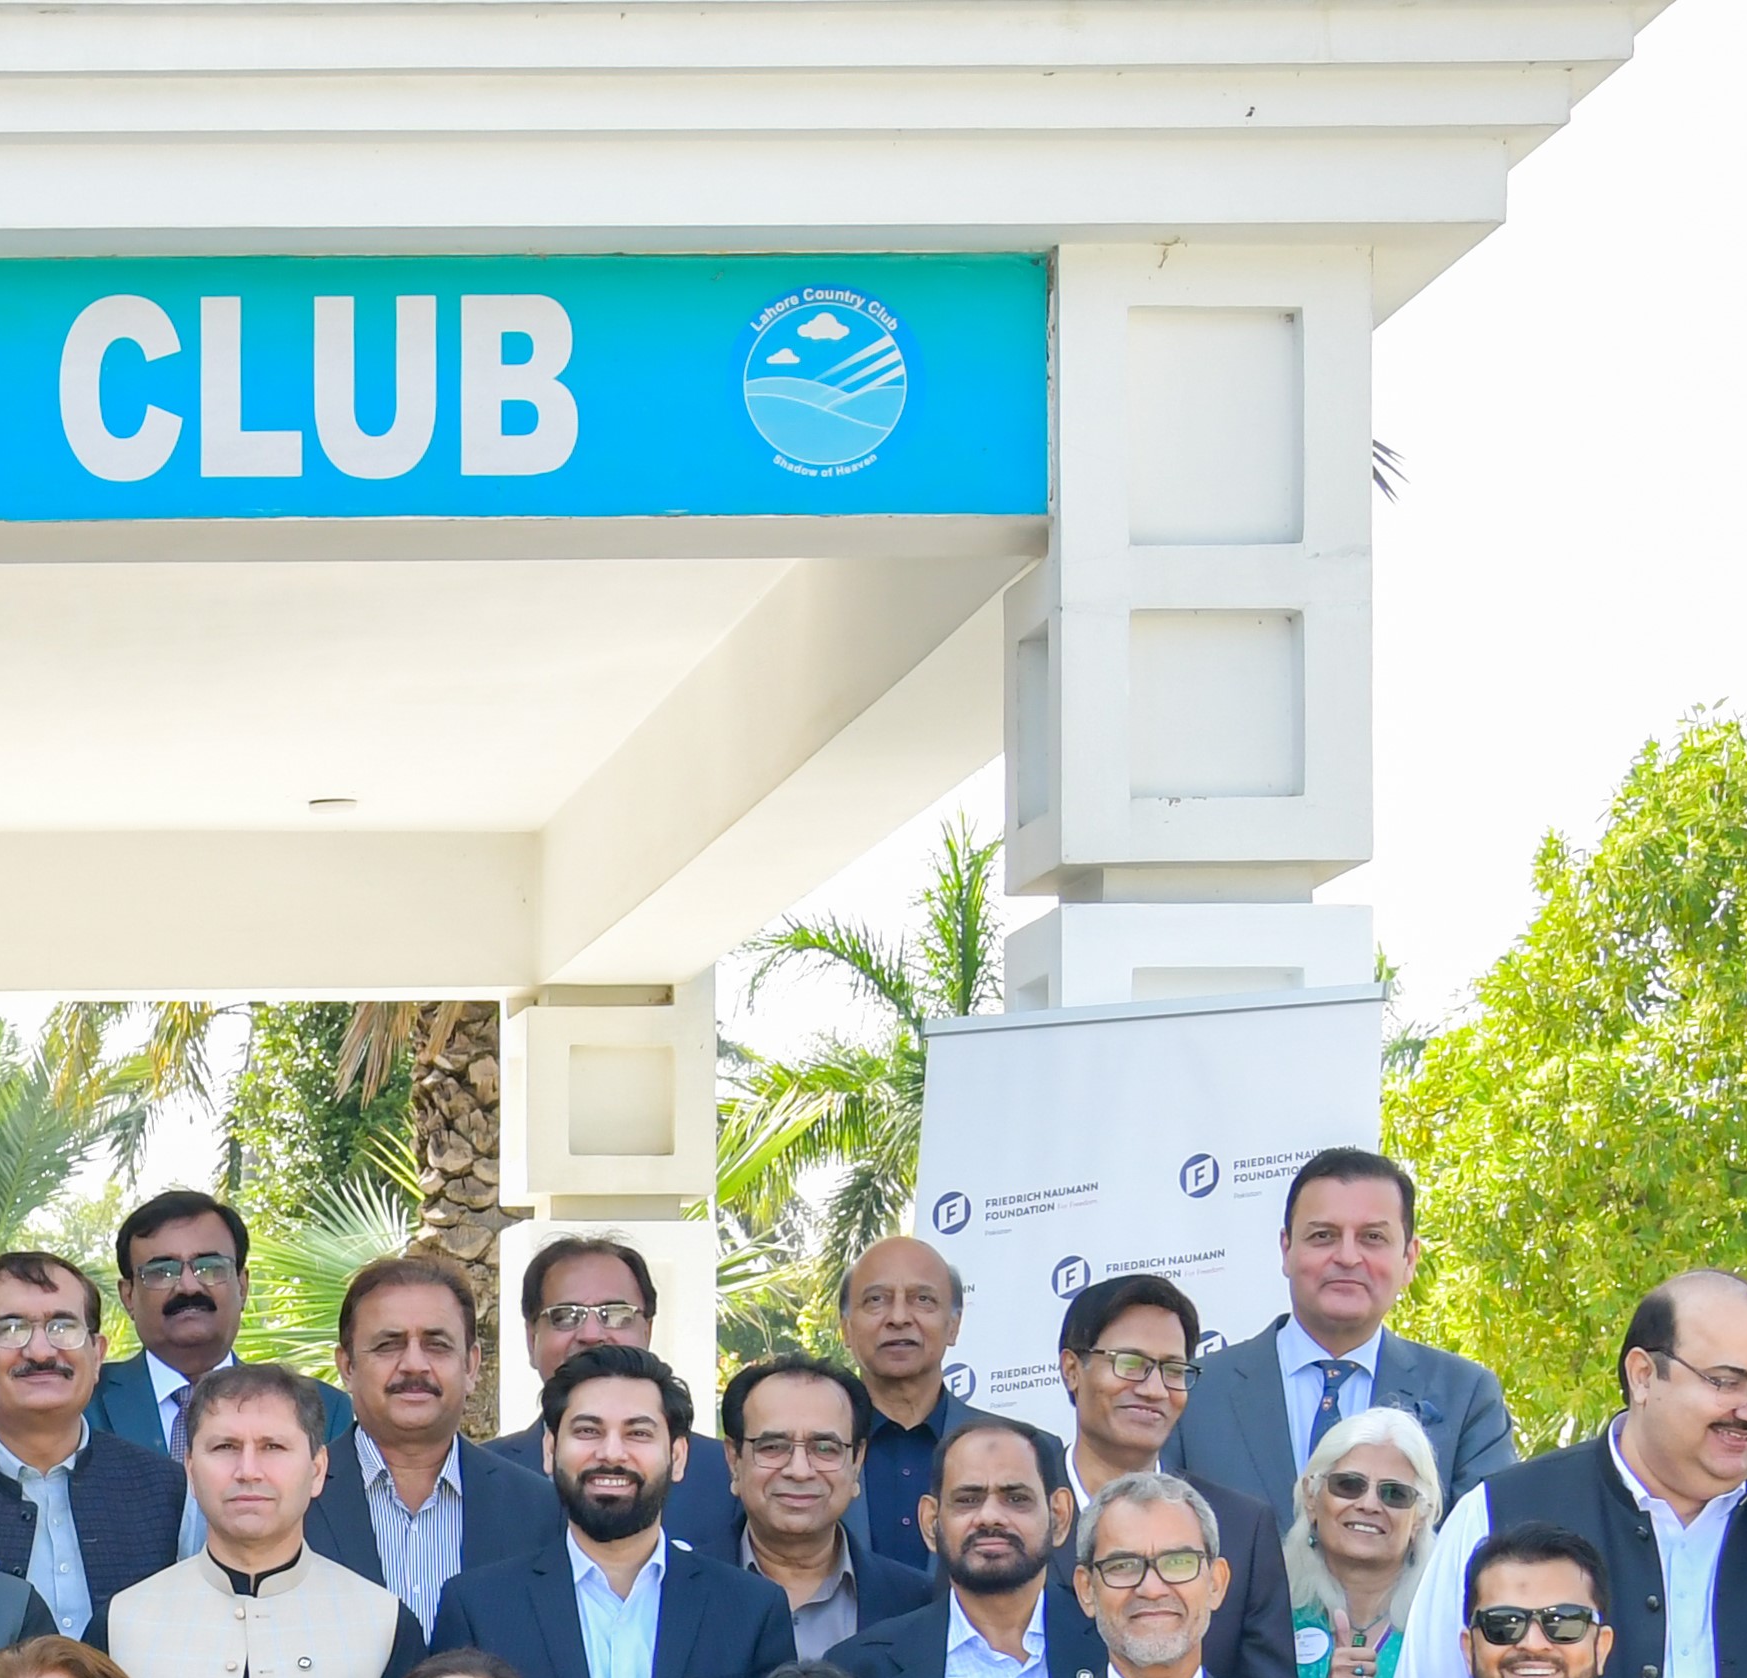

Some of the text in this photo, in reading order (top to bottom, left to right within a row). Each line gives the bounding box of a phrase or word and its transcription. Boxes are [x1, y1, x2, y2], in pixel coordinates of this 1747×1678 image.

[750, 288, 899, 332] Lahore Country Club
[59, 294, 579, 482] CLUB
[772, 453, 878, 478] Shadow of Heaven
[1234, 1153, 1292, 1170] FRIEDRICH
[1194, 1165, 1206, 1187] F
[1234, 1166, 1303, 1184] FOUNDATIO
[985, 1182, 1099, 1208] FRIEDRICH NAUMANN
[946, 1203, 958, 1224] F
[985, 1202, 1055, 1221] FOUNDATION
[1106, 1248, 1225, 1273] FRIEDRICH NAUMANN
[1065, 1267, 1077, 1288] F
[991, 1364, 1045, 1380] FRIEDRICH
[990, 1376, 1060, 1394] FOUNDATION
